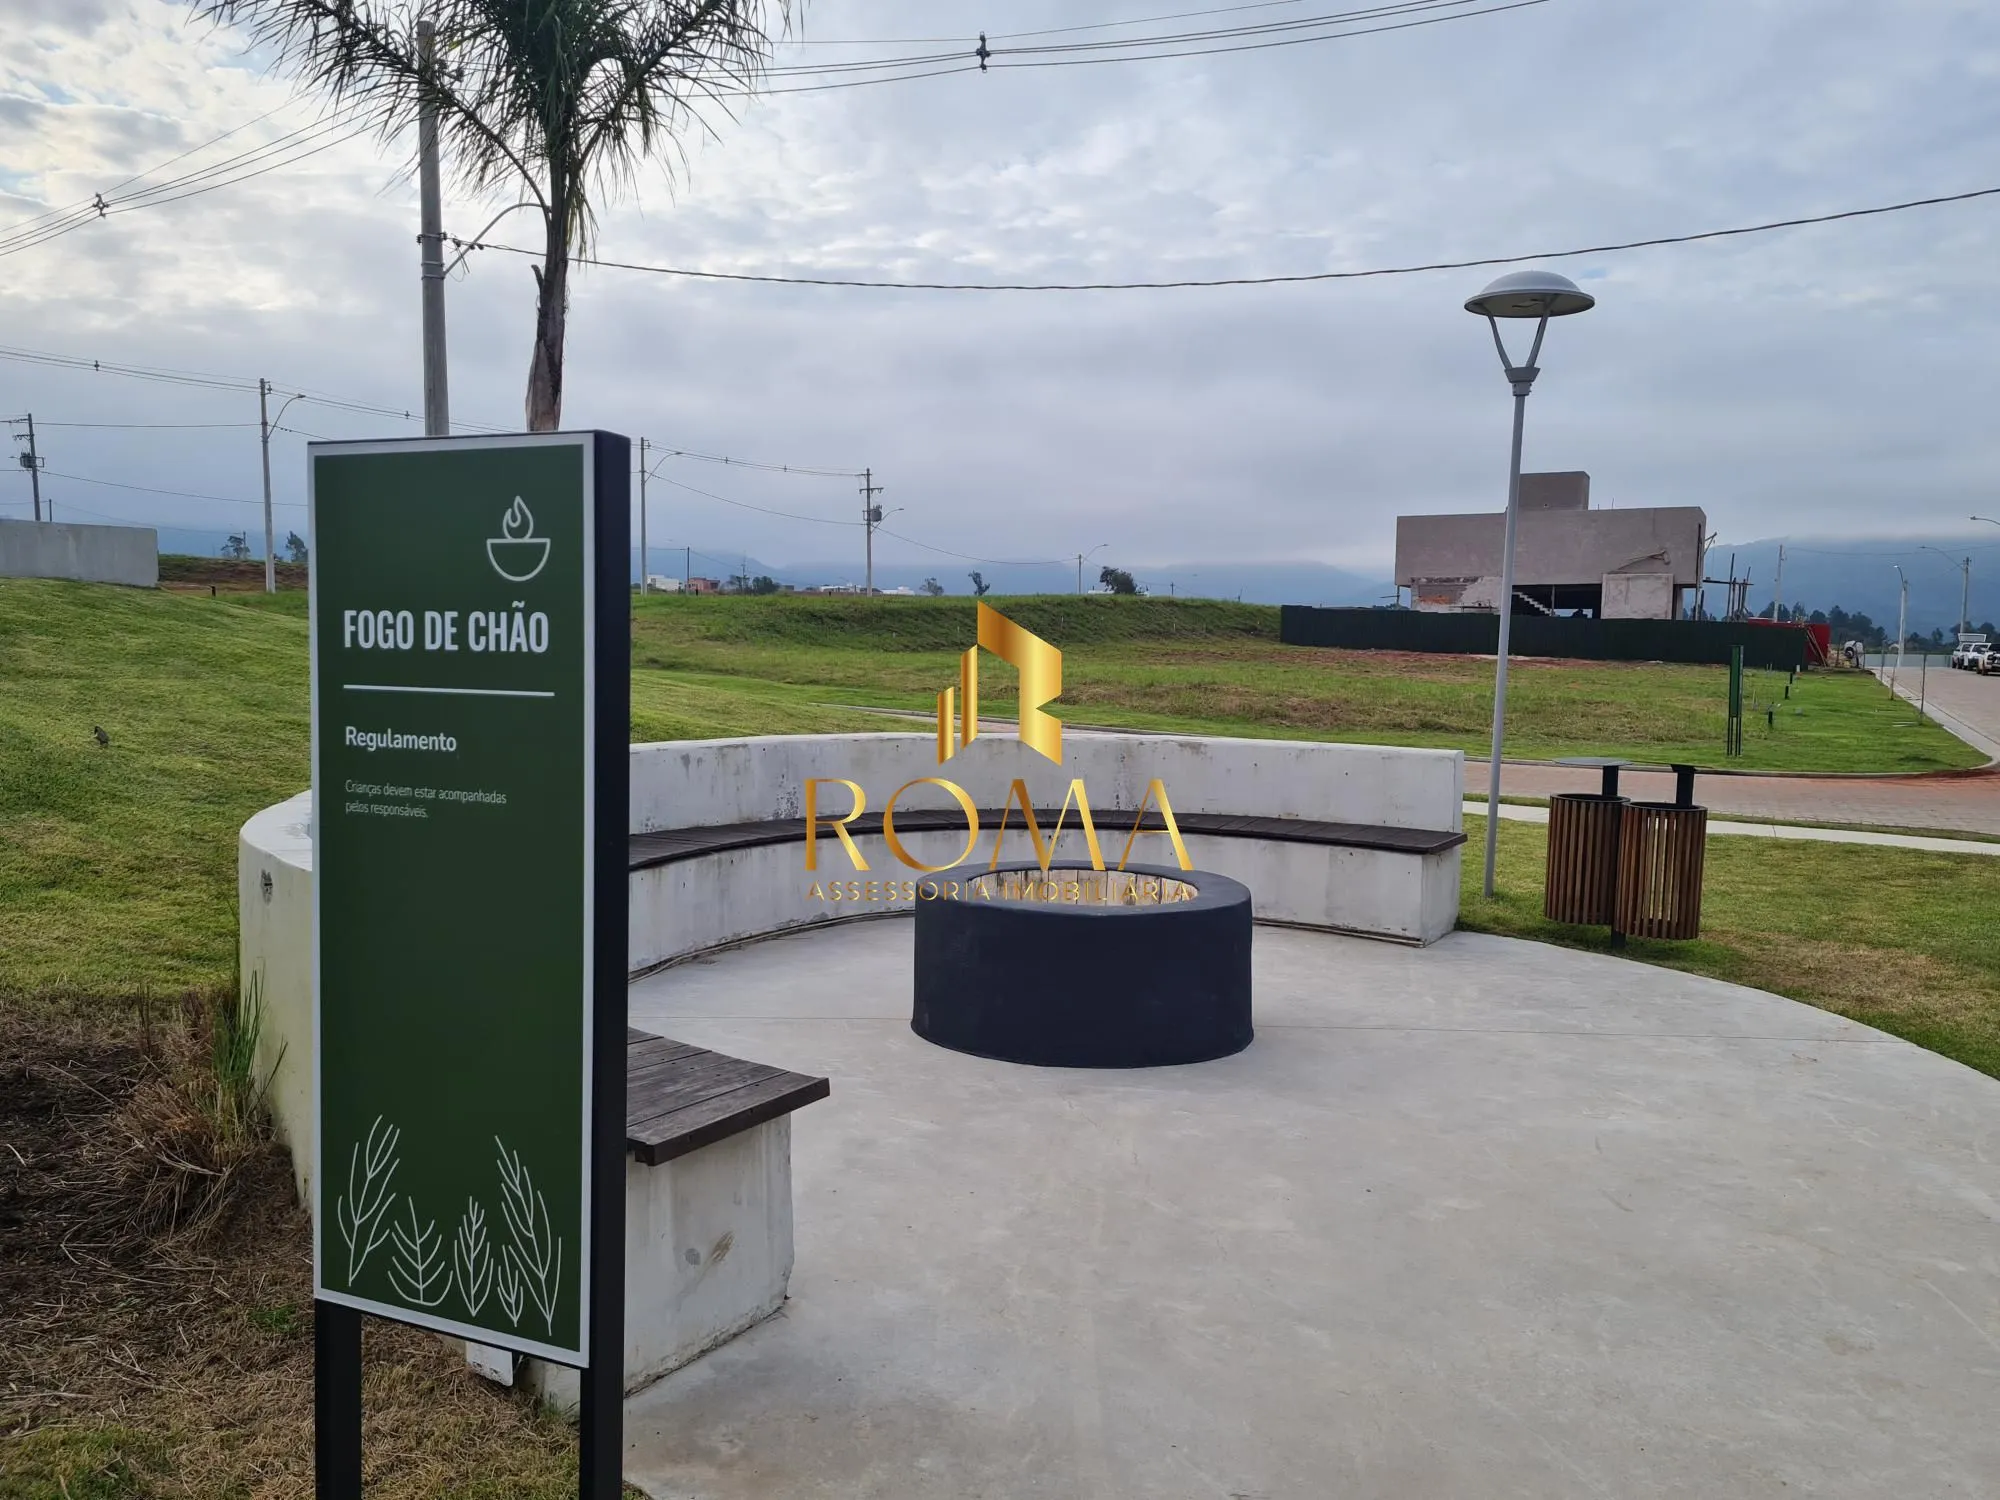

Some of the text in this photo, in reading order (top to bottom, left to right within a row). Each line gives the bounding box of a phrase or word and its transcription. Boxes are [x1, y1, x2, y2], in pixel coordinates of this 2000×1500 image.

[343, 600, 549, 653] FOGO DE CHÃO
[345, 725, 457, 753] Regulamento
[345, 779, 508, 804] Crianças devem estar acompanhadas
[345, 800, 429, 818] pelos responsáveis.
